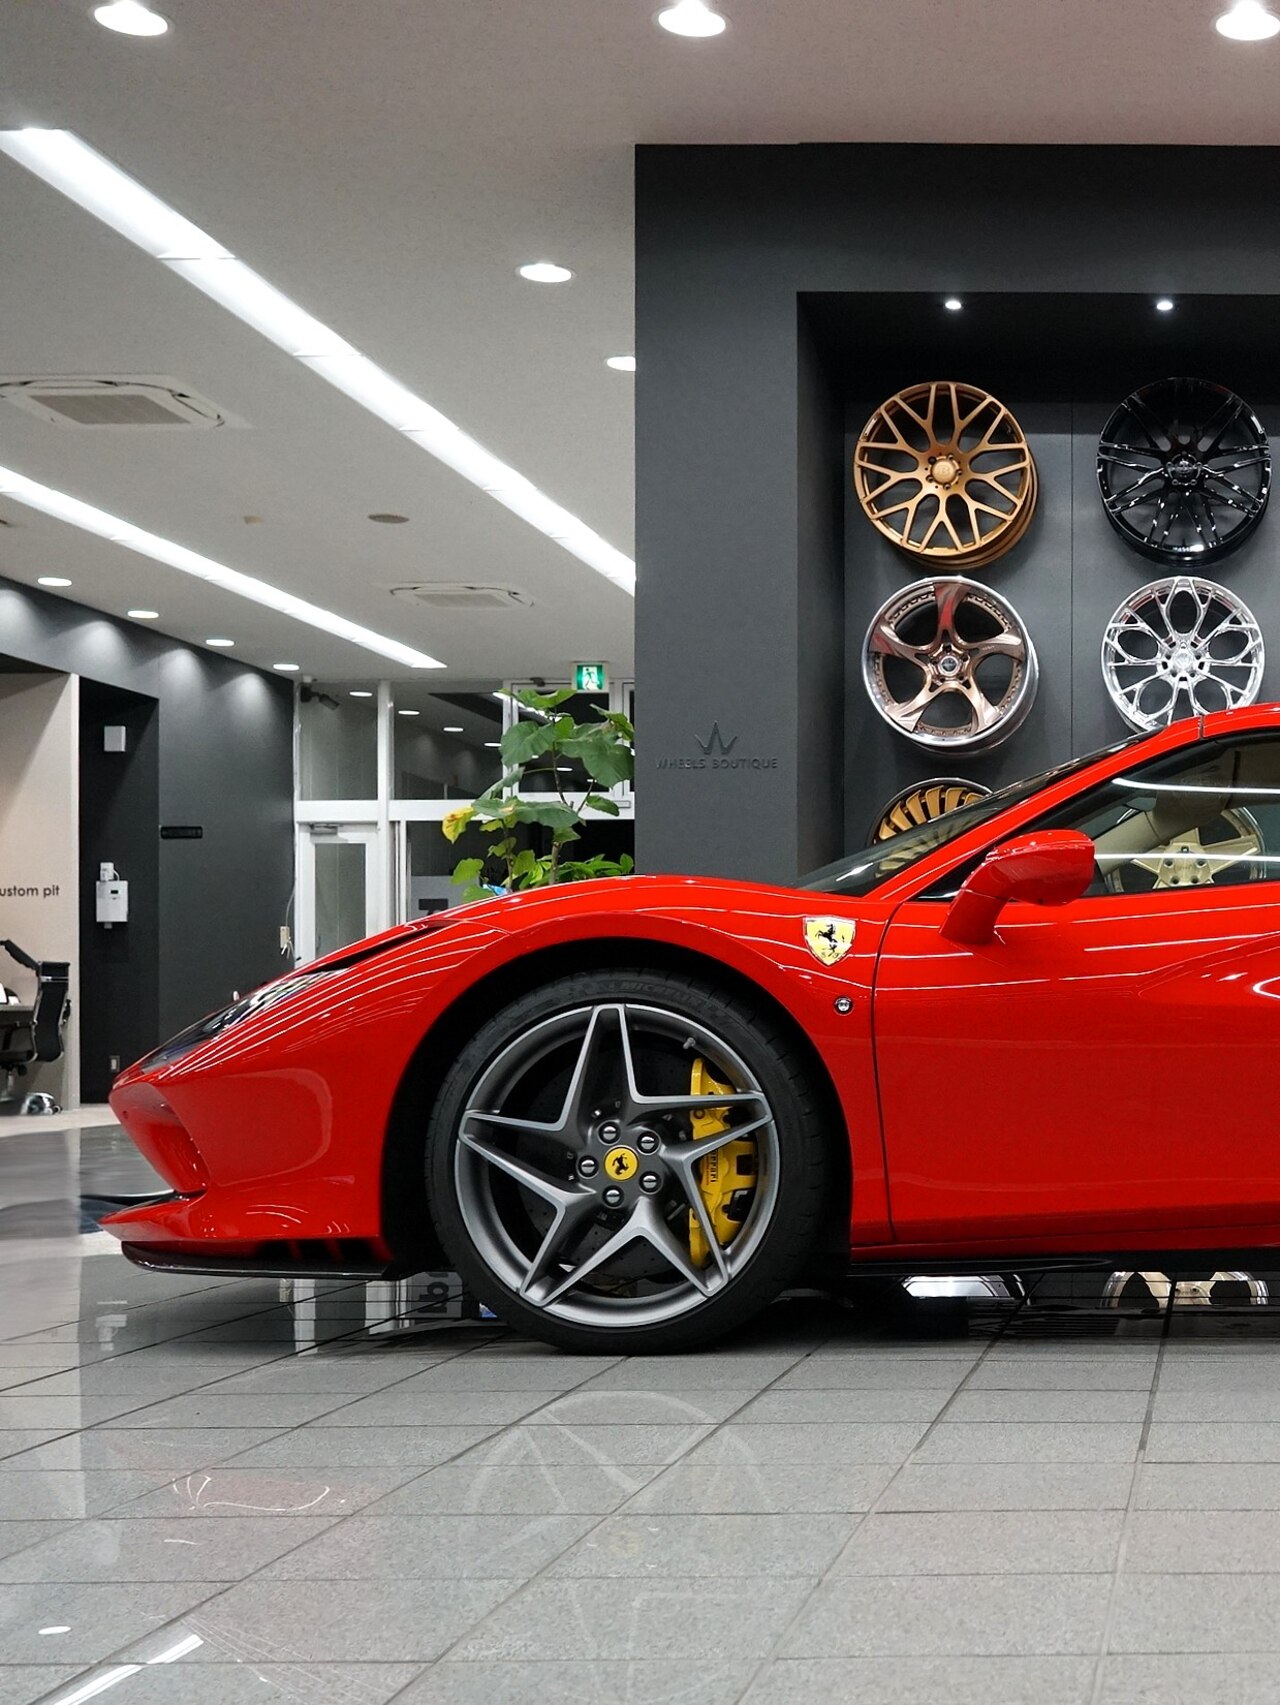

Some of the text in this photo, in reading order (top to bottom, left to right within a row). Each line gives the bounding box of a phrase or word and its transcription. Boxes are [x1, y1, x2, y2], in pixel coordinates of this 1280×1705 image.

[656, 758, 779, 770] WHEELS BOUTIQUE
[0, 884, 60, 899] ustom pit
